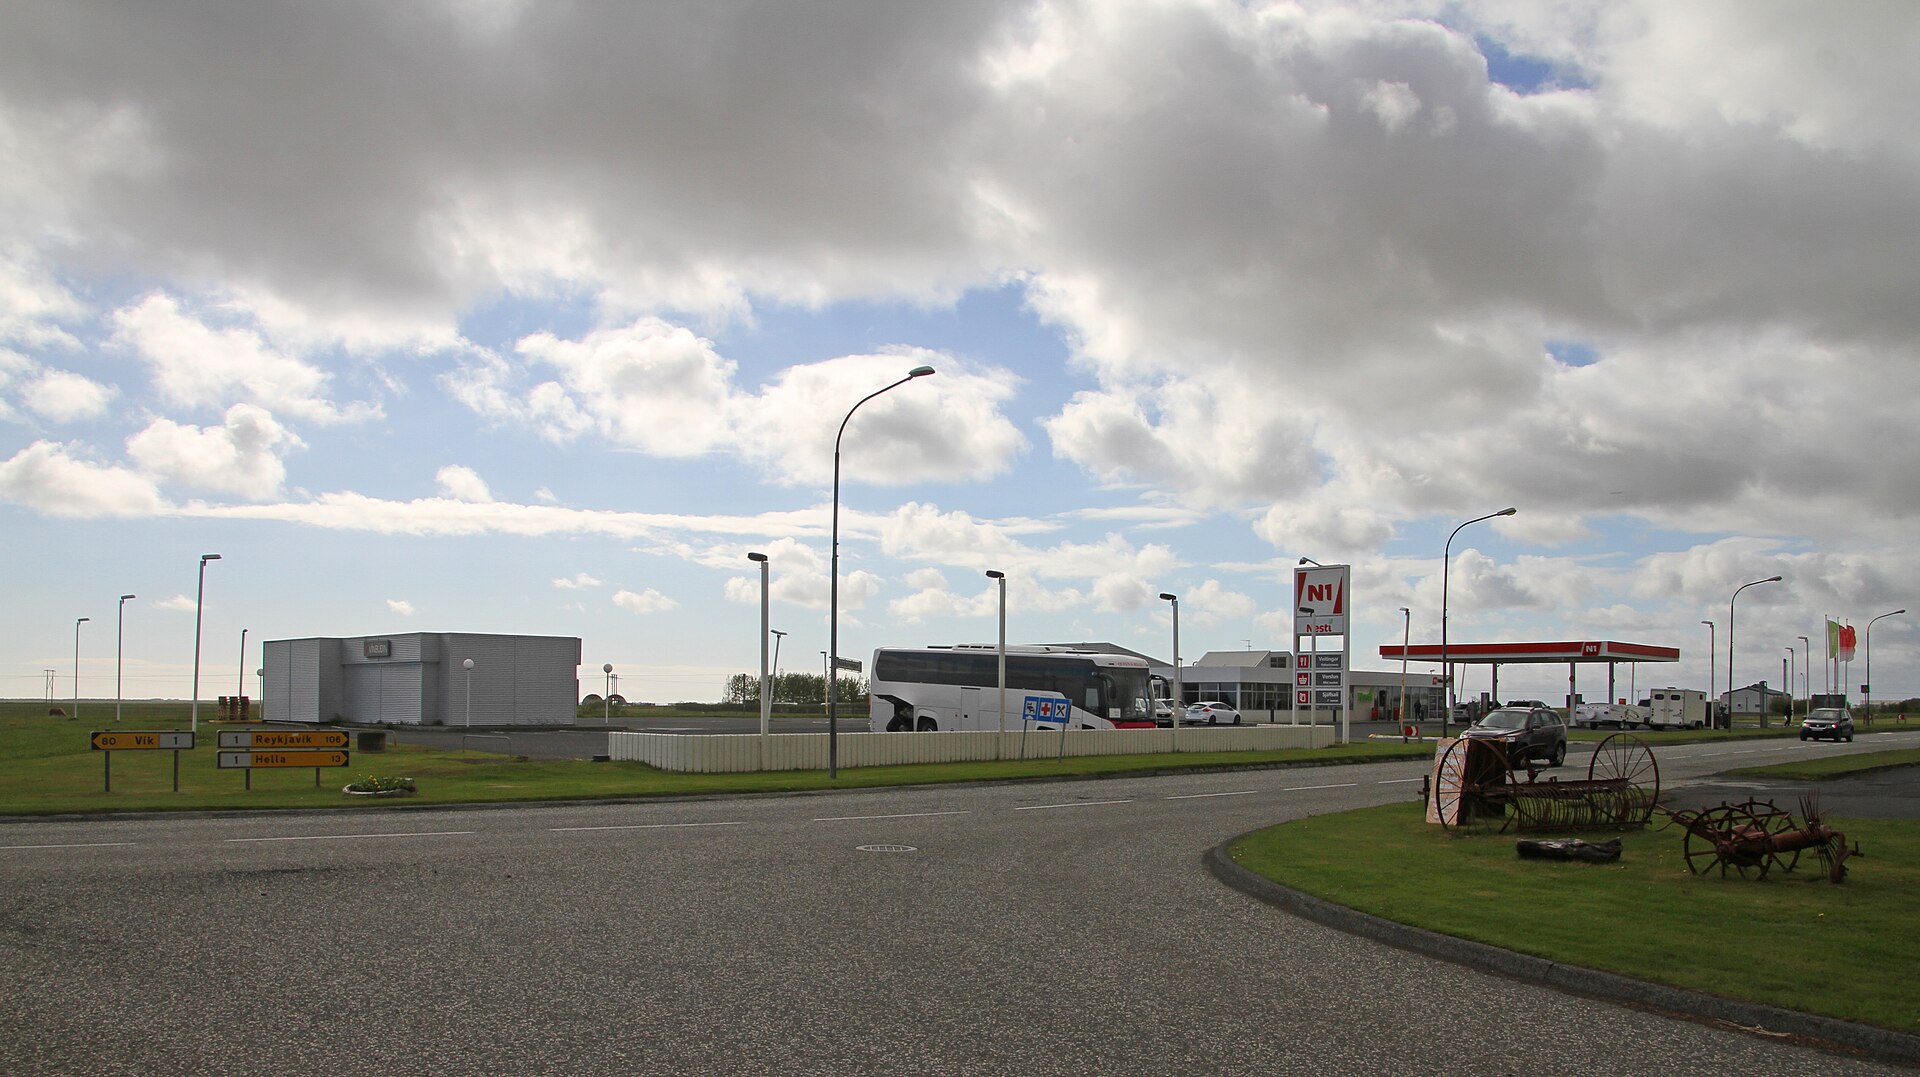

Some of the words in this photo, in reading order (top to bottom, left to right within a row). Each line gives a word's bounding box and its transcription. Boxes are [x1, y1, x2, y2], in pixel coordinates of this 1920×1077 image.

[1307, 584, 1332, 601] N1
[102, 737, 117, 745] 80
[173, 736, 178, 745] 1
[234, 735, 239, 744] 1
[325, 736, 341, 744] 106
[234, 755, 239, 764] 1
[255, 755, 286, 764] Hella
[331, 755, 341, 763] 13
